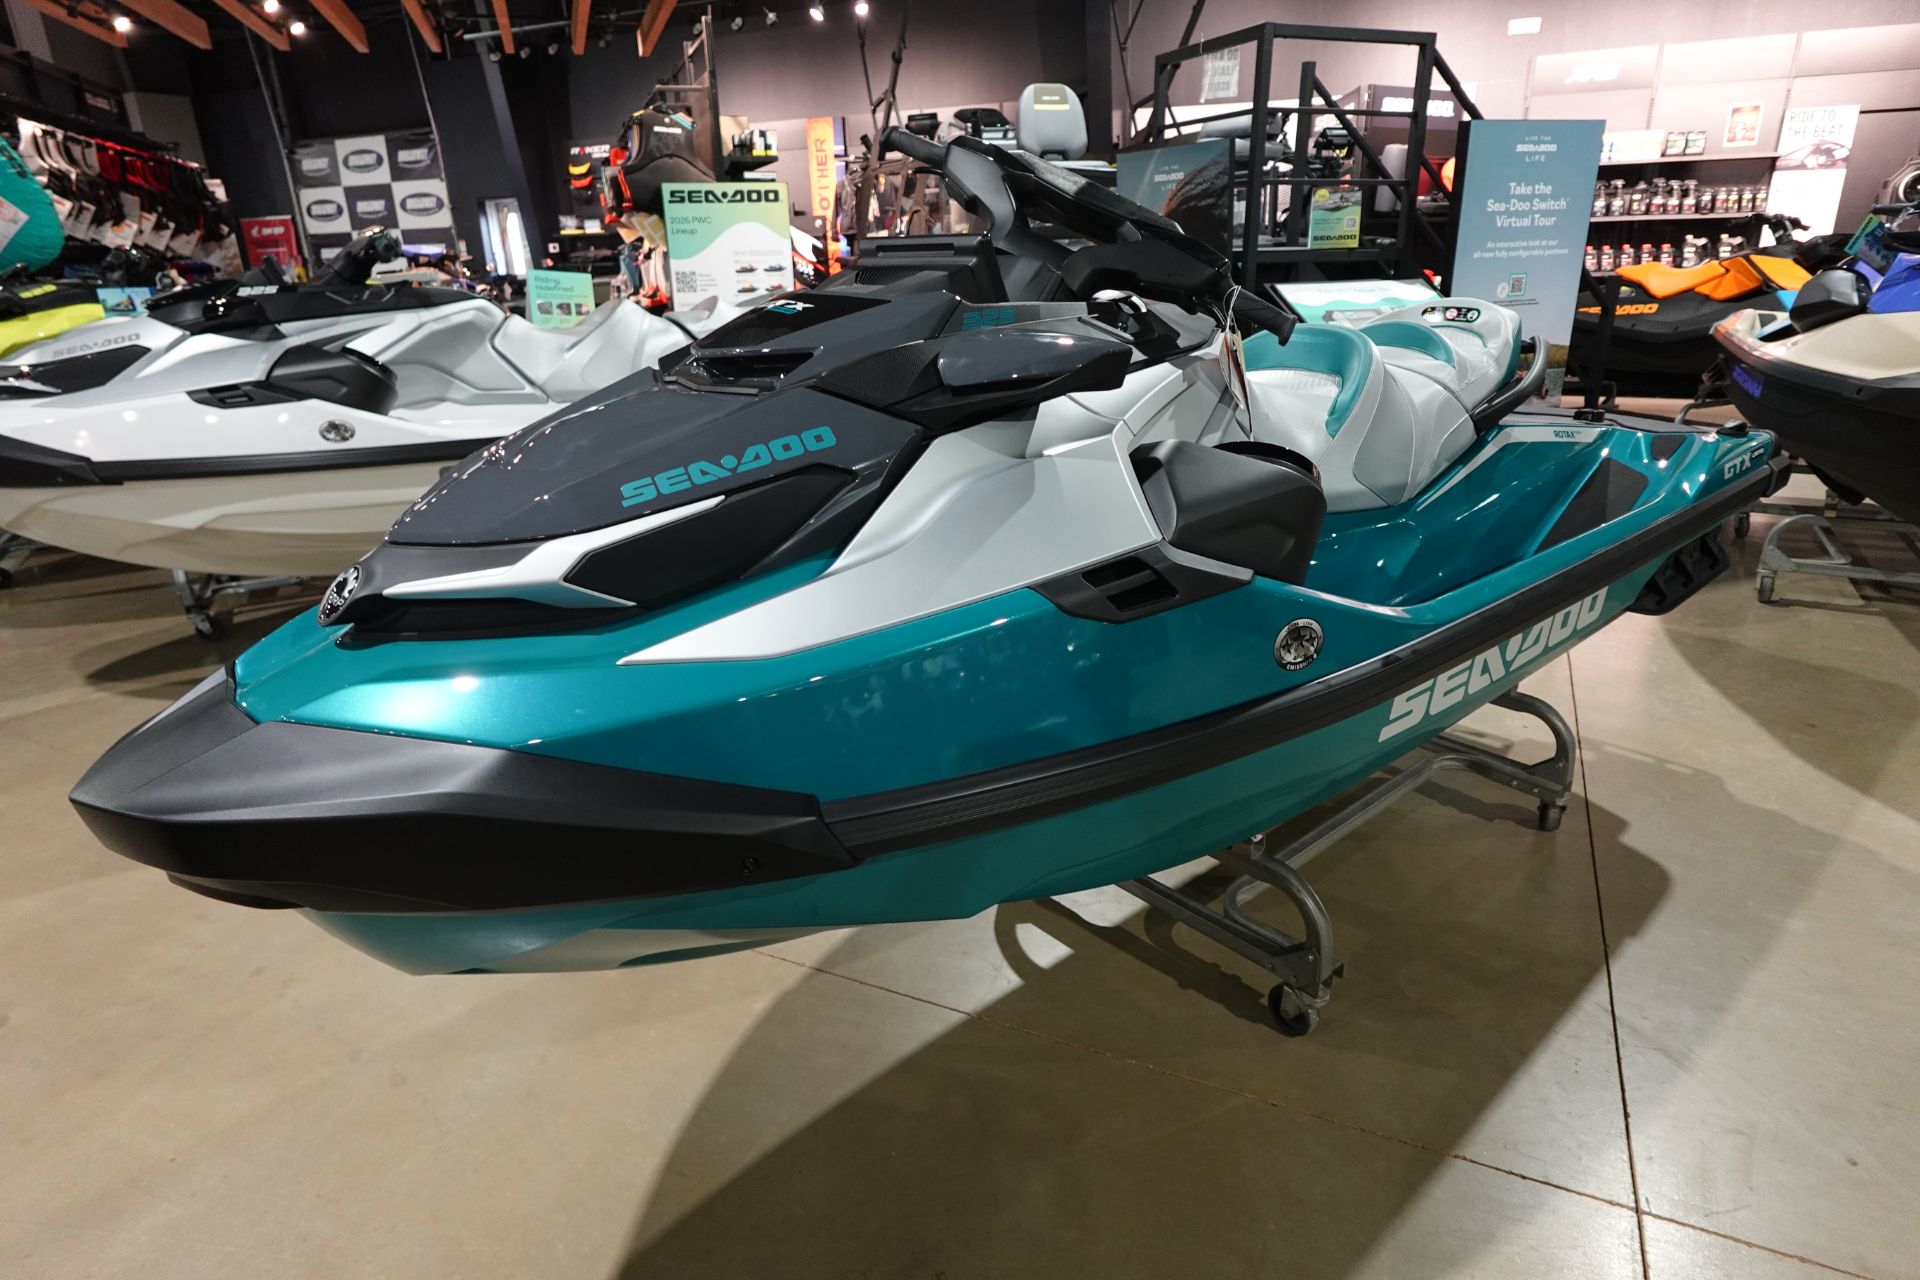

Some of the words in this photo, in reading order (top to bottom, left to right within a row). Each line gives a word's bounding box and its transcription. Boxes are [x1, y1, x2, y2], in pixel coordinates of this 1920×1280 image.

[1509, 182, 1533, 195] Take
[1535, 182, 1552, 195] the
[1486, 199, 1530, 212] Sea-Doo
[670, 216, 691, 224] 2026
[692, 216, 713, 224] PWC
[1496, 214, 1531, 228] Virtual
[1534, 214, 1557, 226] Tour
[671, 227, 698, 236] Lineup
[1724, 452, 1752, 480] GTX
